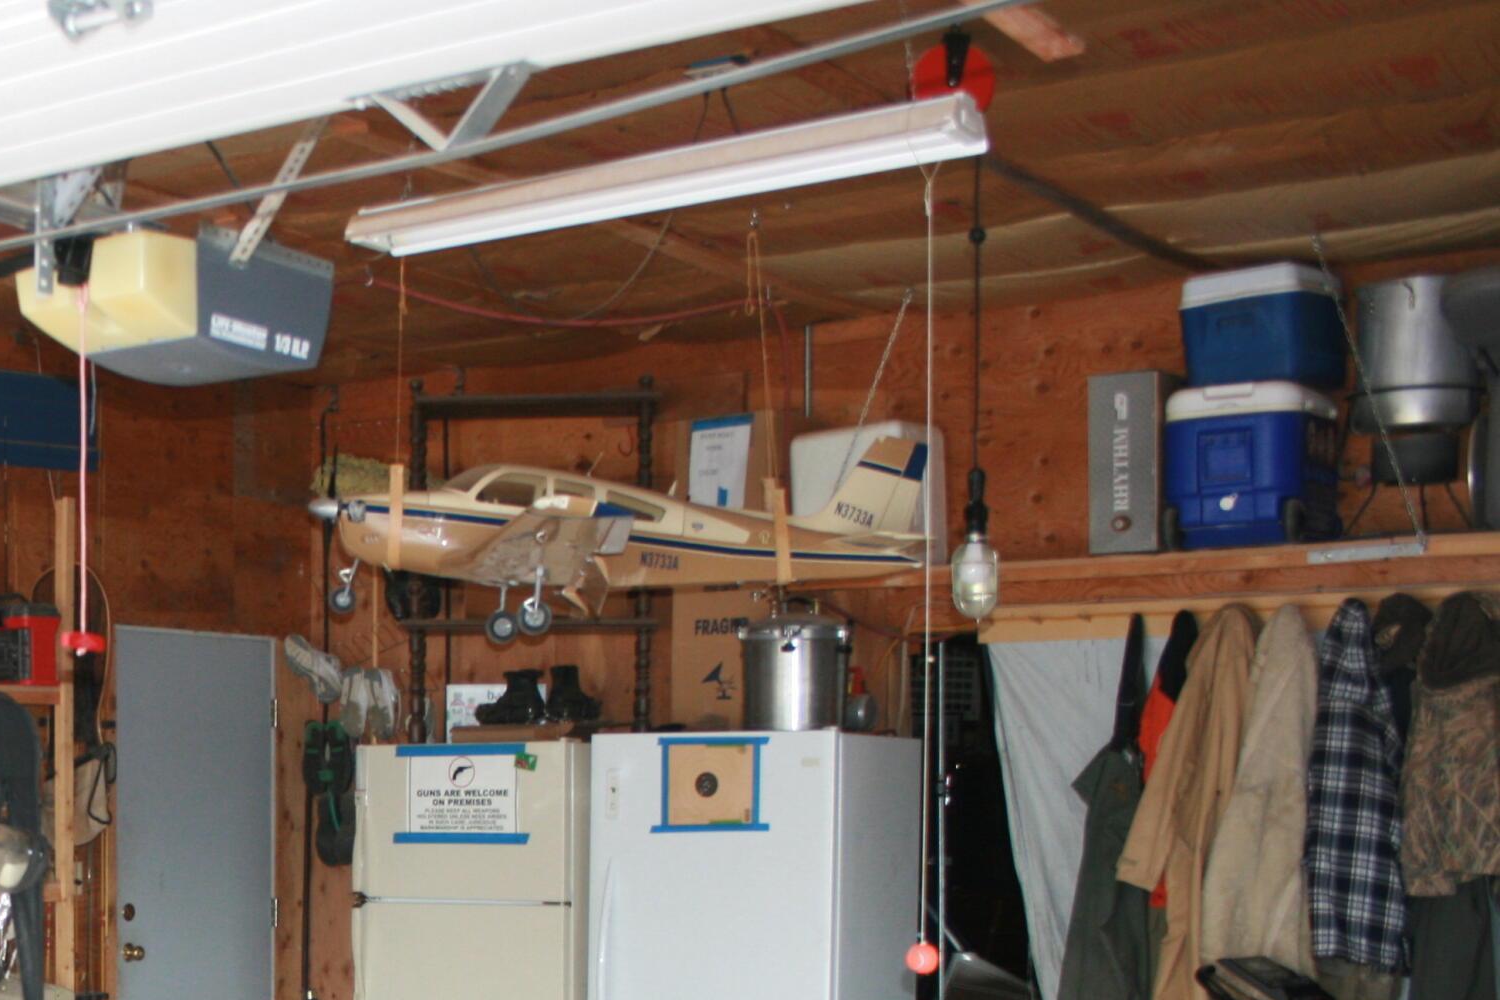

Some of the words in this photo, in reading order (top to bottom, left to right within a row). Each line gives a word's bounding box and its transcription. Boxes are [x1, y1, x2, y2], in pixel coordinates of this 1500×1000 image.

[1113, 429, 1130, 511] RHYTHM
[835, 501, 873, 528] N3733A
[641, 551, 679, 570] N3733A
[417, 789, 441, 797] GUNS
[444, 789, 461, 797] ARE
[464, 789, 508, 797] WELCOME
[432, 798, 445, 806] ON
[447, 798, 492, 806] PREMISES
